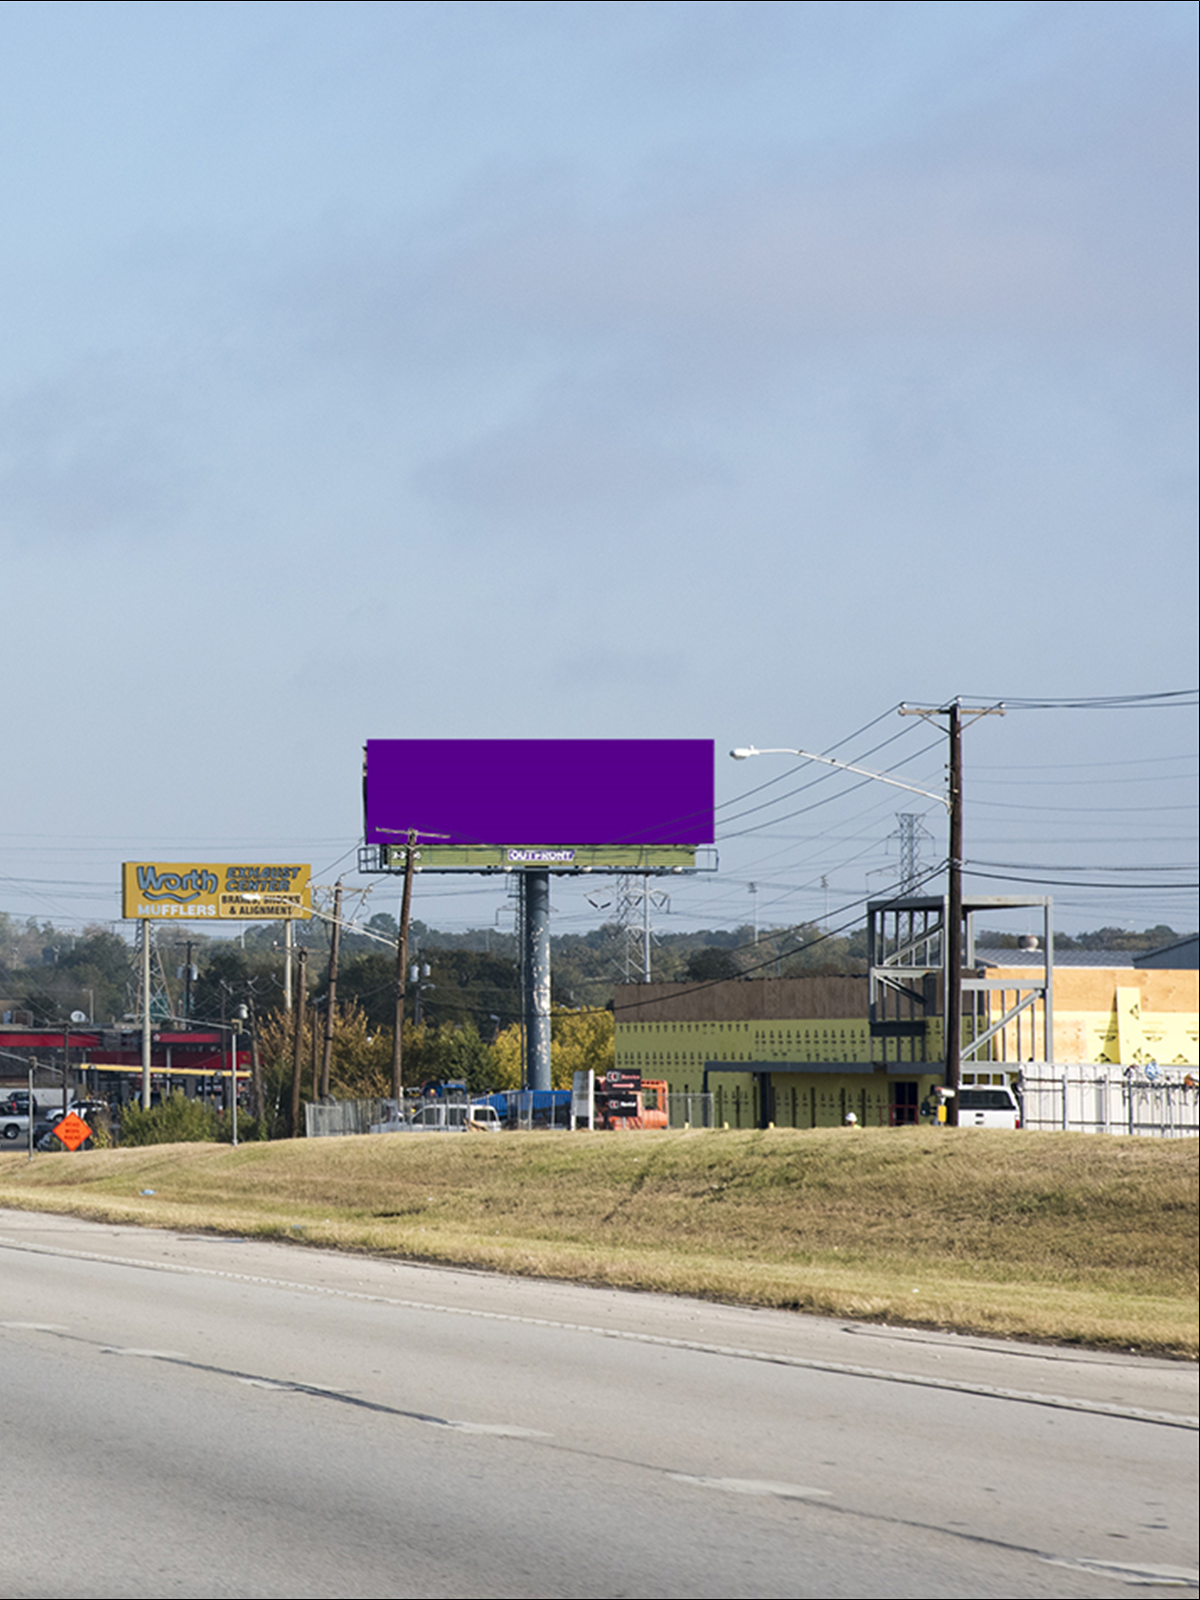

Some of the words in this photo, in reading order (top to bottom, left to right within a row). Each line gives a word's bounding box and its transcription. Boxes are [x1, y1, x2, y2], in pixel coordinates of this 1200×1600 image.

[509, 850, 574, 860] OUTFRONT
[225, 866, 301, 879] EXHAUST
[136, 865, 218, 893] Worth
[225, 879, 291, 892] CENTER
[137, 904, 216, 916] MUFFLERS
[229, 906, 236, 915] &
[239, 906, 292, 915] ALIGNMENT
